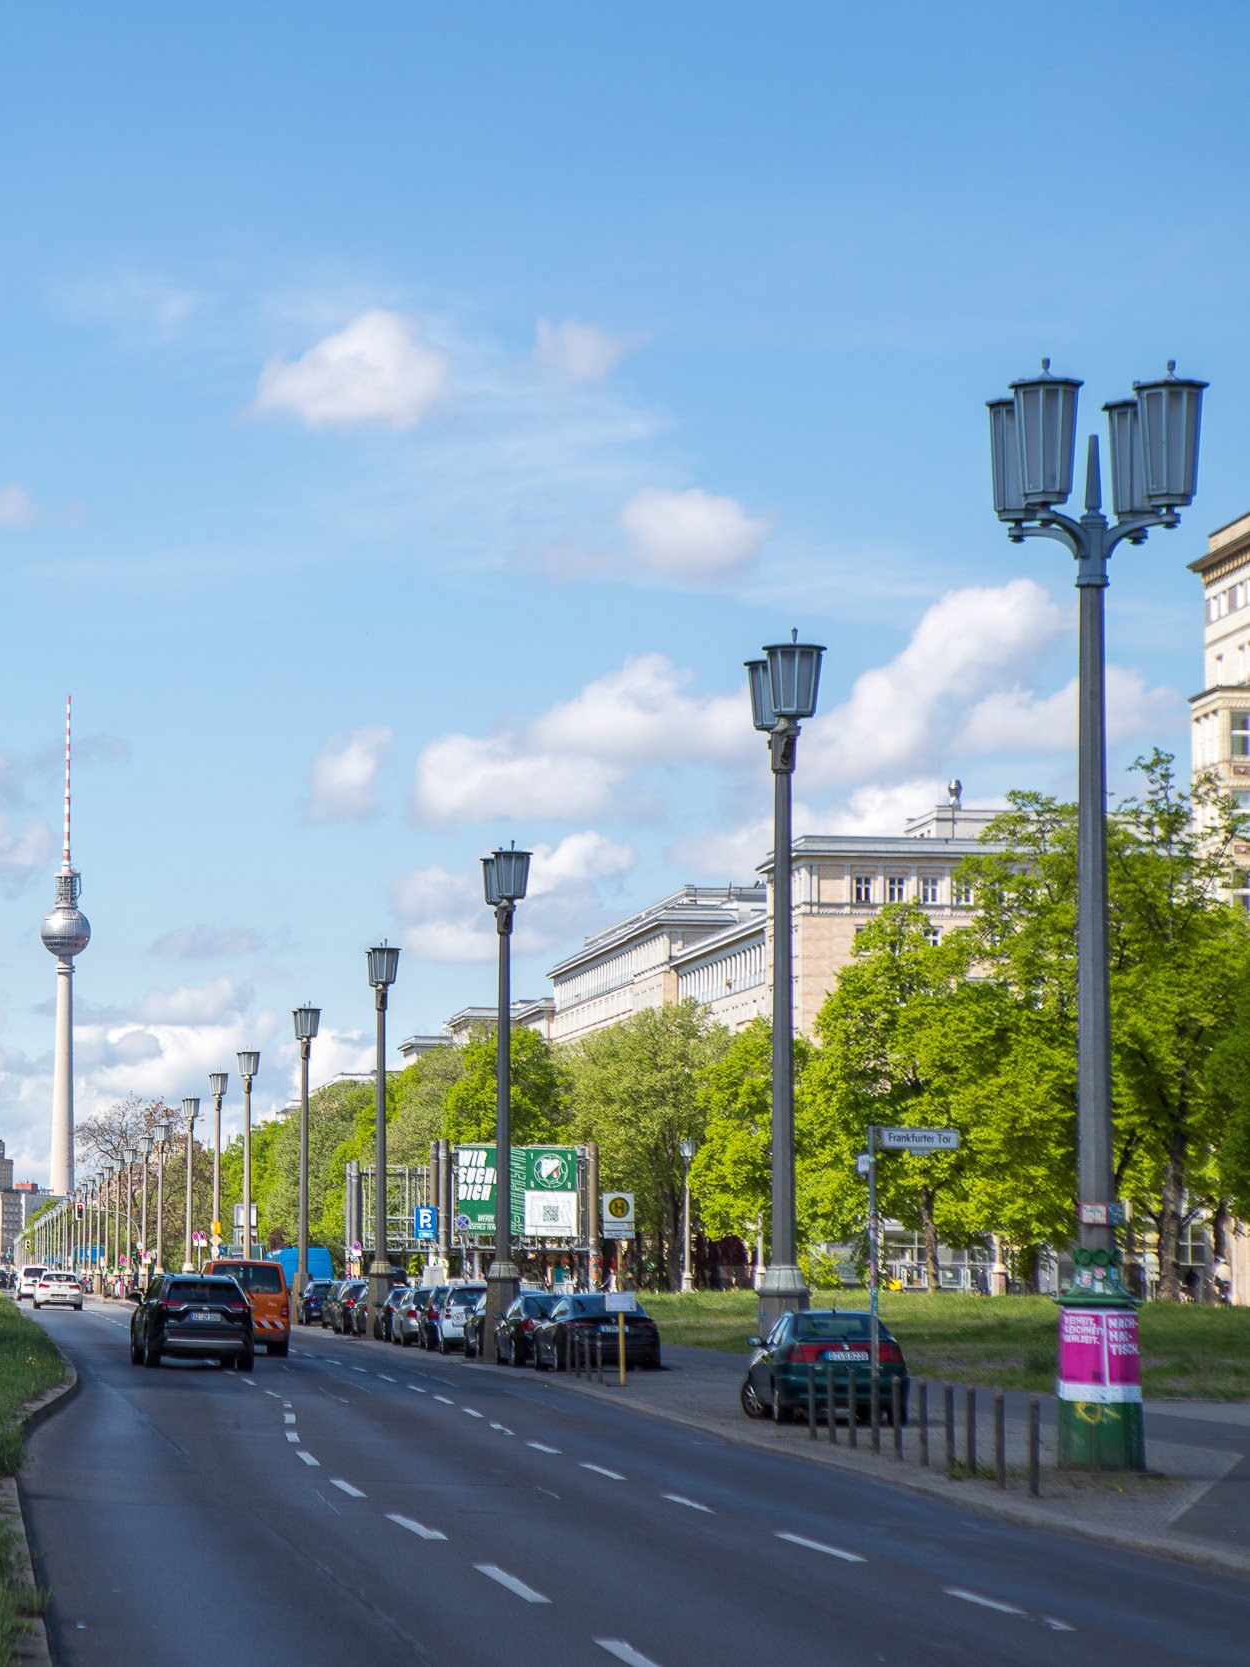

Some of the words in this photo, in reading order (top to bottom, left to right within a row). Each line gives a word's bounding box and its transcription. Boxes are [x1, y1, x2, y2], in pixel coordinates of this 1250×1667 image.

[888, 1132, 934, 1144] Frankfurter
[937, 1134, 952, 1144] Tor
[458, 1150, 487, 1167] WIR
[458, 1167, 497, 1185] SUCH
[458, 1184, 492, 1201] DICH
